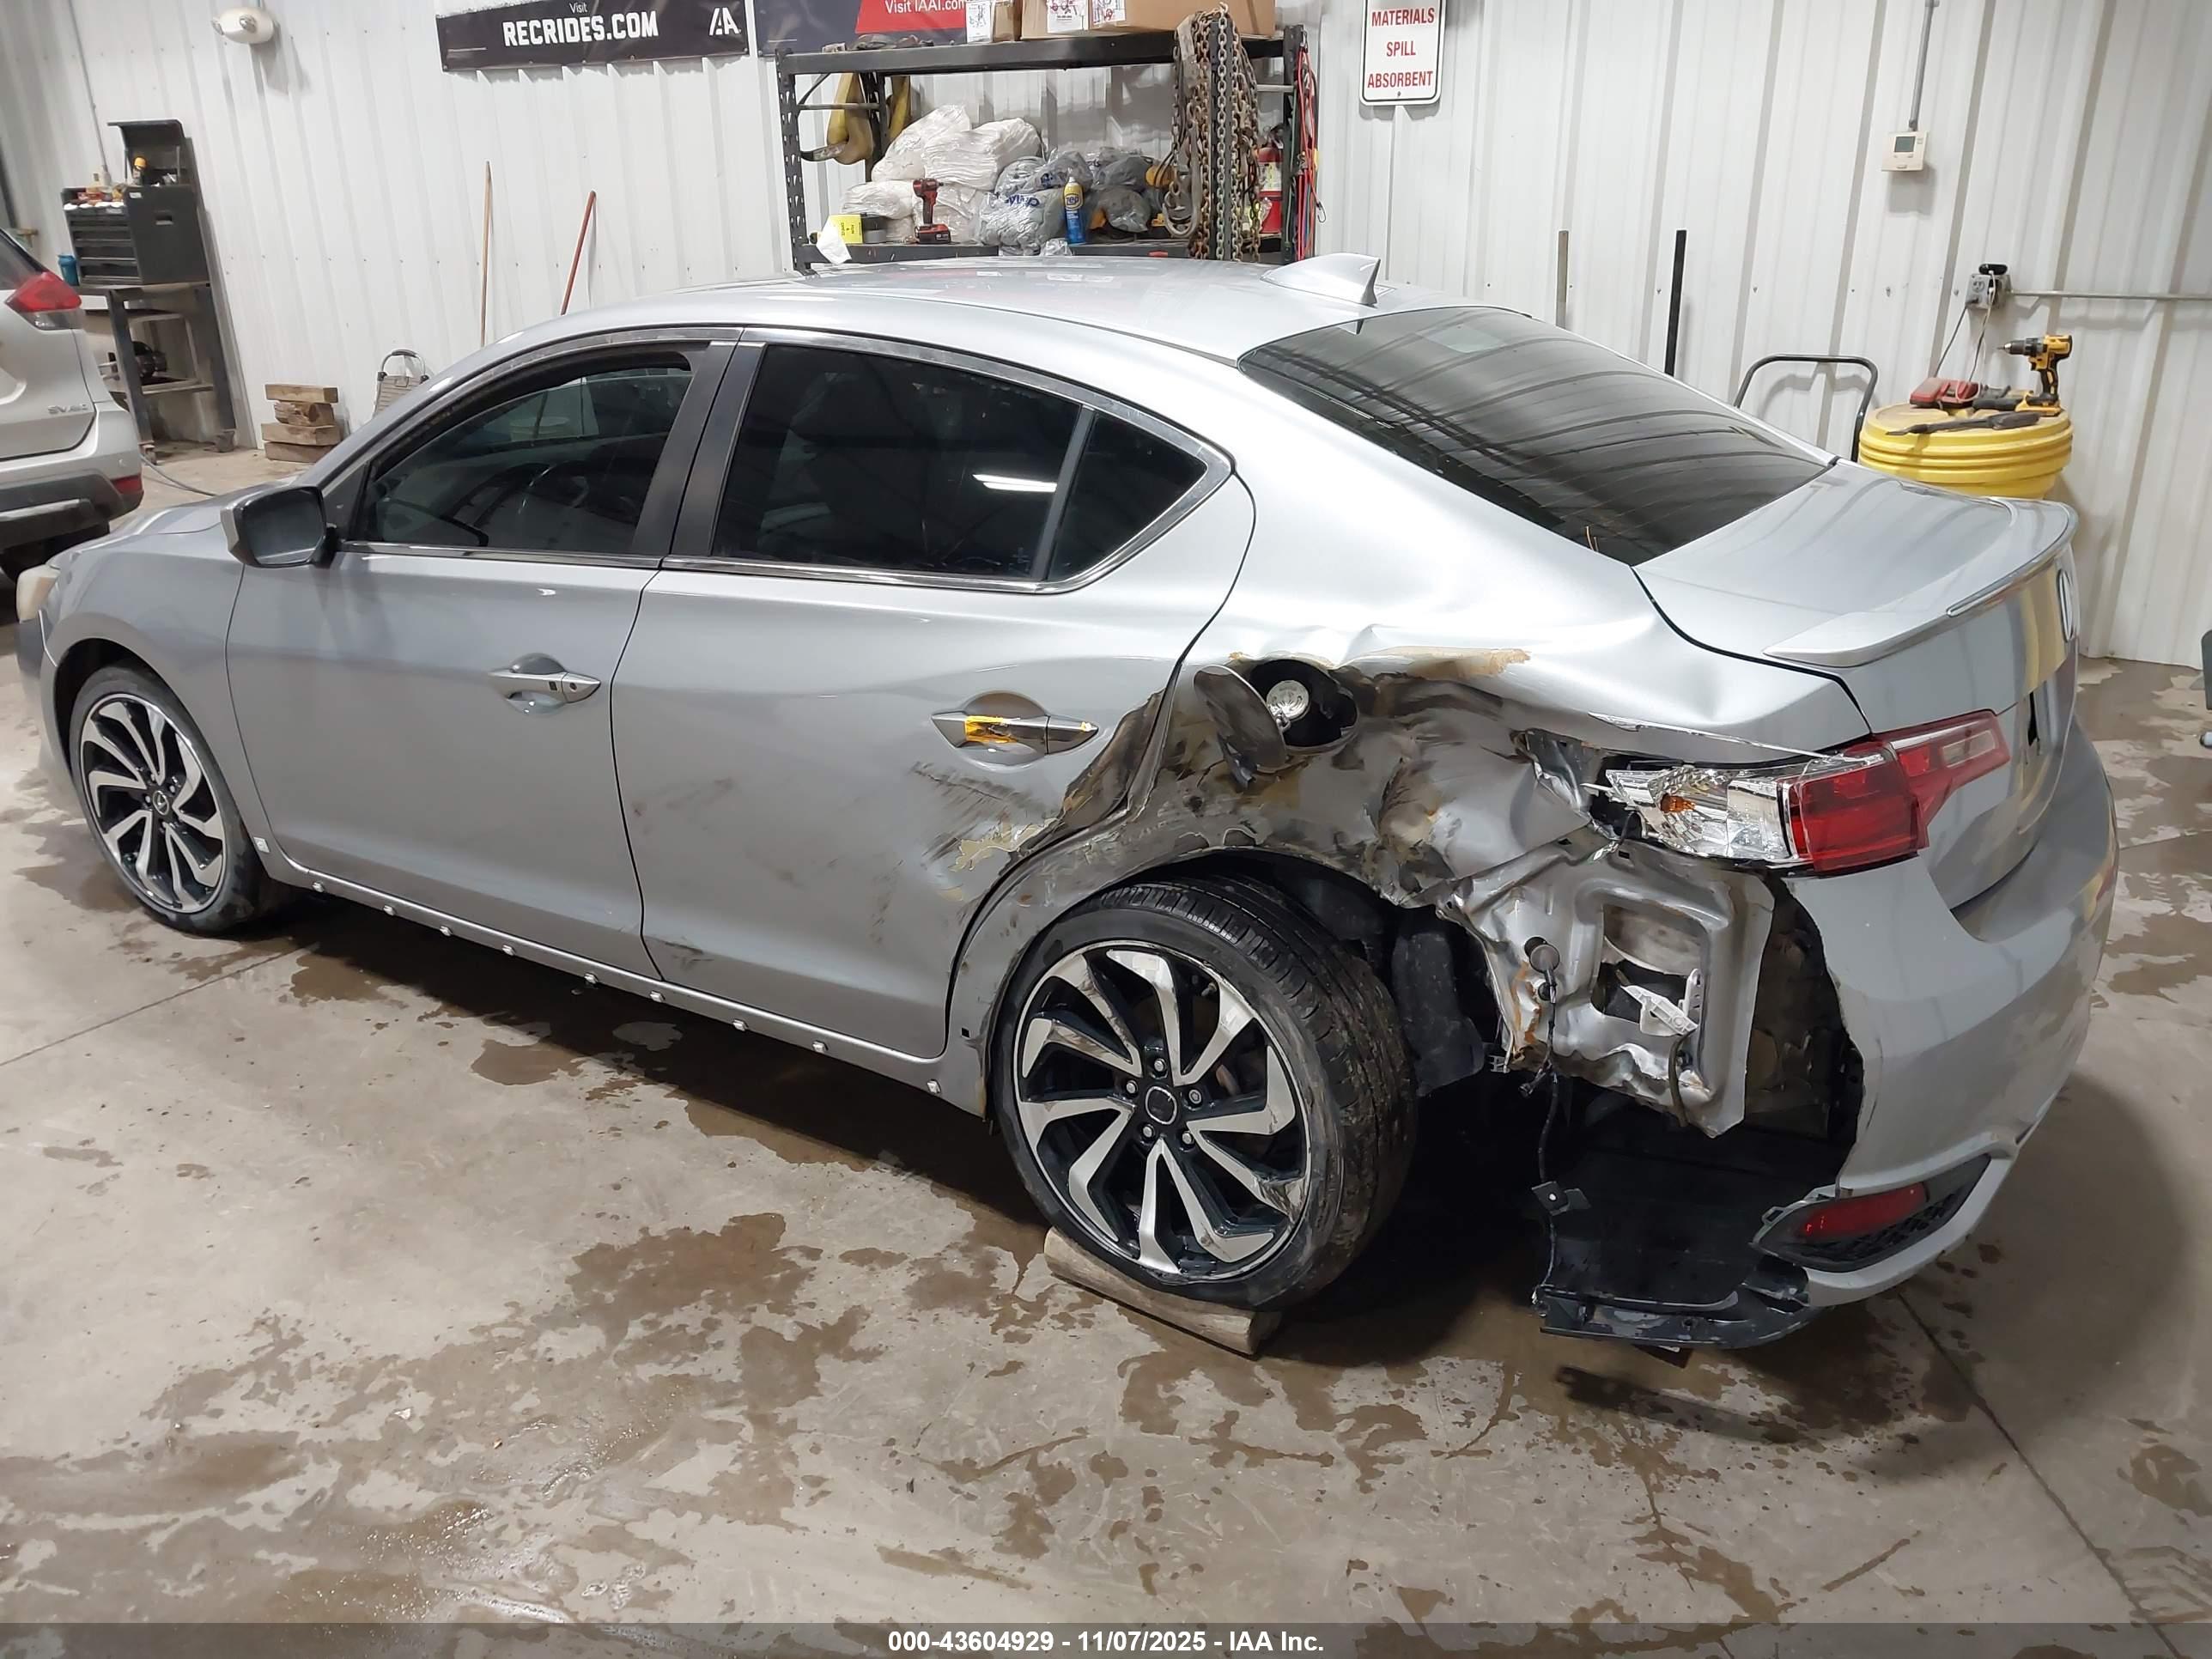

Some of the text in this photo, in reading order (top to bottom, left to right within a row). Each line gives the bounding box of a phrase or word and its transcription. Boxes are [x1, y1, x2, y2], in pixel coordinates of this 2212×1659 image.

[568, 2, 588, 15] Visit
[884, 0, 912, 14] Visit
[1371, 8, 1435, 27] MATERIALS
[501, 10, 659, 46] RECRIDES.COM
[1386, 40, 1416, 57] SPILL
[1367, 70, 1433, 88] ABSORBENT
